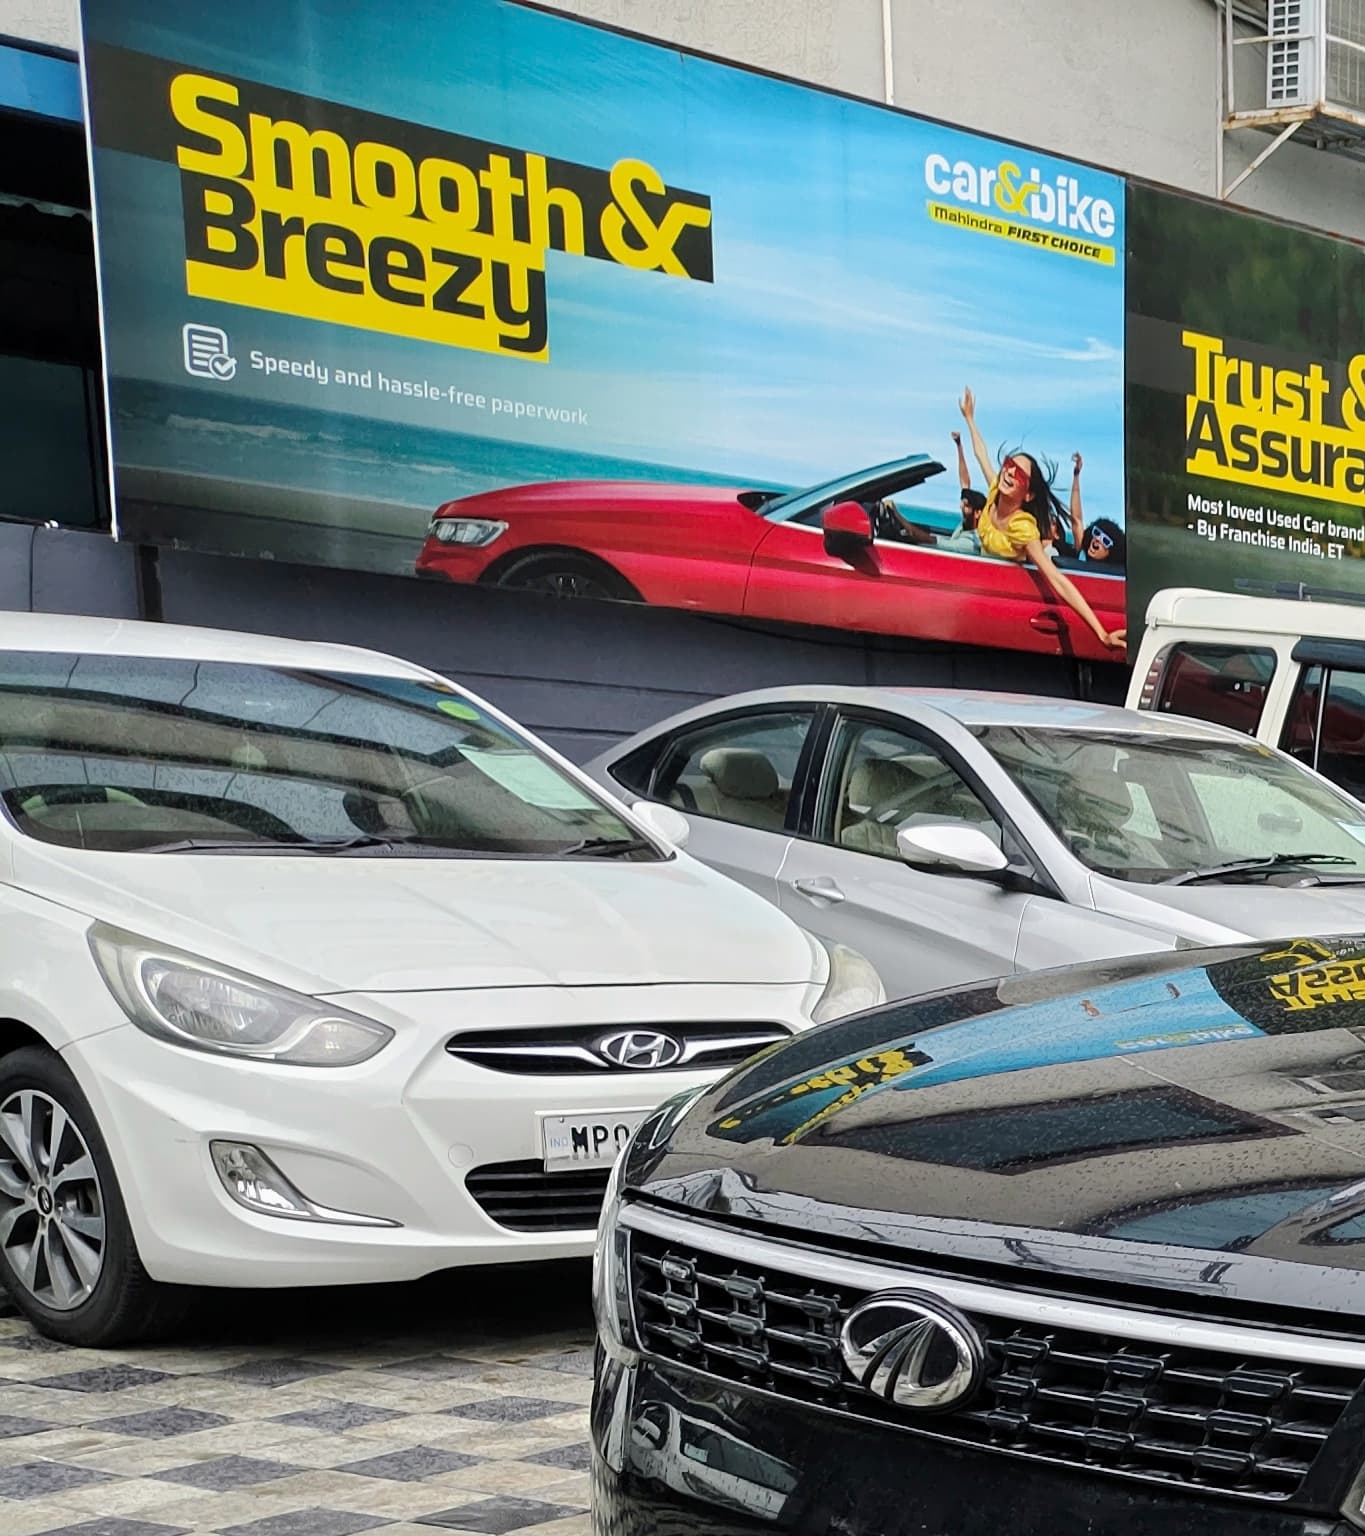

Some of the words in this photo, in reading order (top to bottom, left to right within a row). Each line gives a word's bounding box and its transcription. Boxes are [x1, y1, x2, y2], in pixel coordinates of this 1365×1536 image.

[170, 73, 585, 256] Smooth
[599, 157, 712, 279] &
[924, 153, 1116, 239] car&bike
[186, 175, 549, 355] Breezy
[1007, 225, 1049, 246] FIRST
[1051, 236, 1102, 259] CHOICE
[250, 350, 329, 385] Speedy
[334, 367, 373, 389] and
[378, 372, 487, 409] hassle-free
[491, 396, 589, 425] paperwork
[1181, 329, 1330, 427] Trust
[1187, 493, 1224, 515] Most
[1226, 500, 1264, 524] loved
[1266, 508, 1301, 530] Used
[1303, 516, 1326, 534] Car
[1327, 519, 1365, 542] brand
[1197, 519, 1217, 542] By
[1219, 523, 1286, 550] Franchise
[1288, 535, 1326, 560] India,
[1327, 542, 1345, 561] ET
